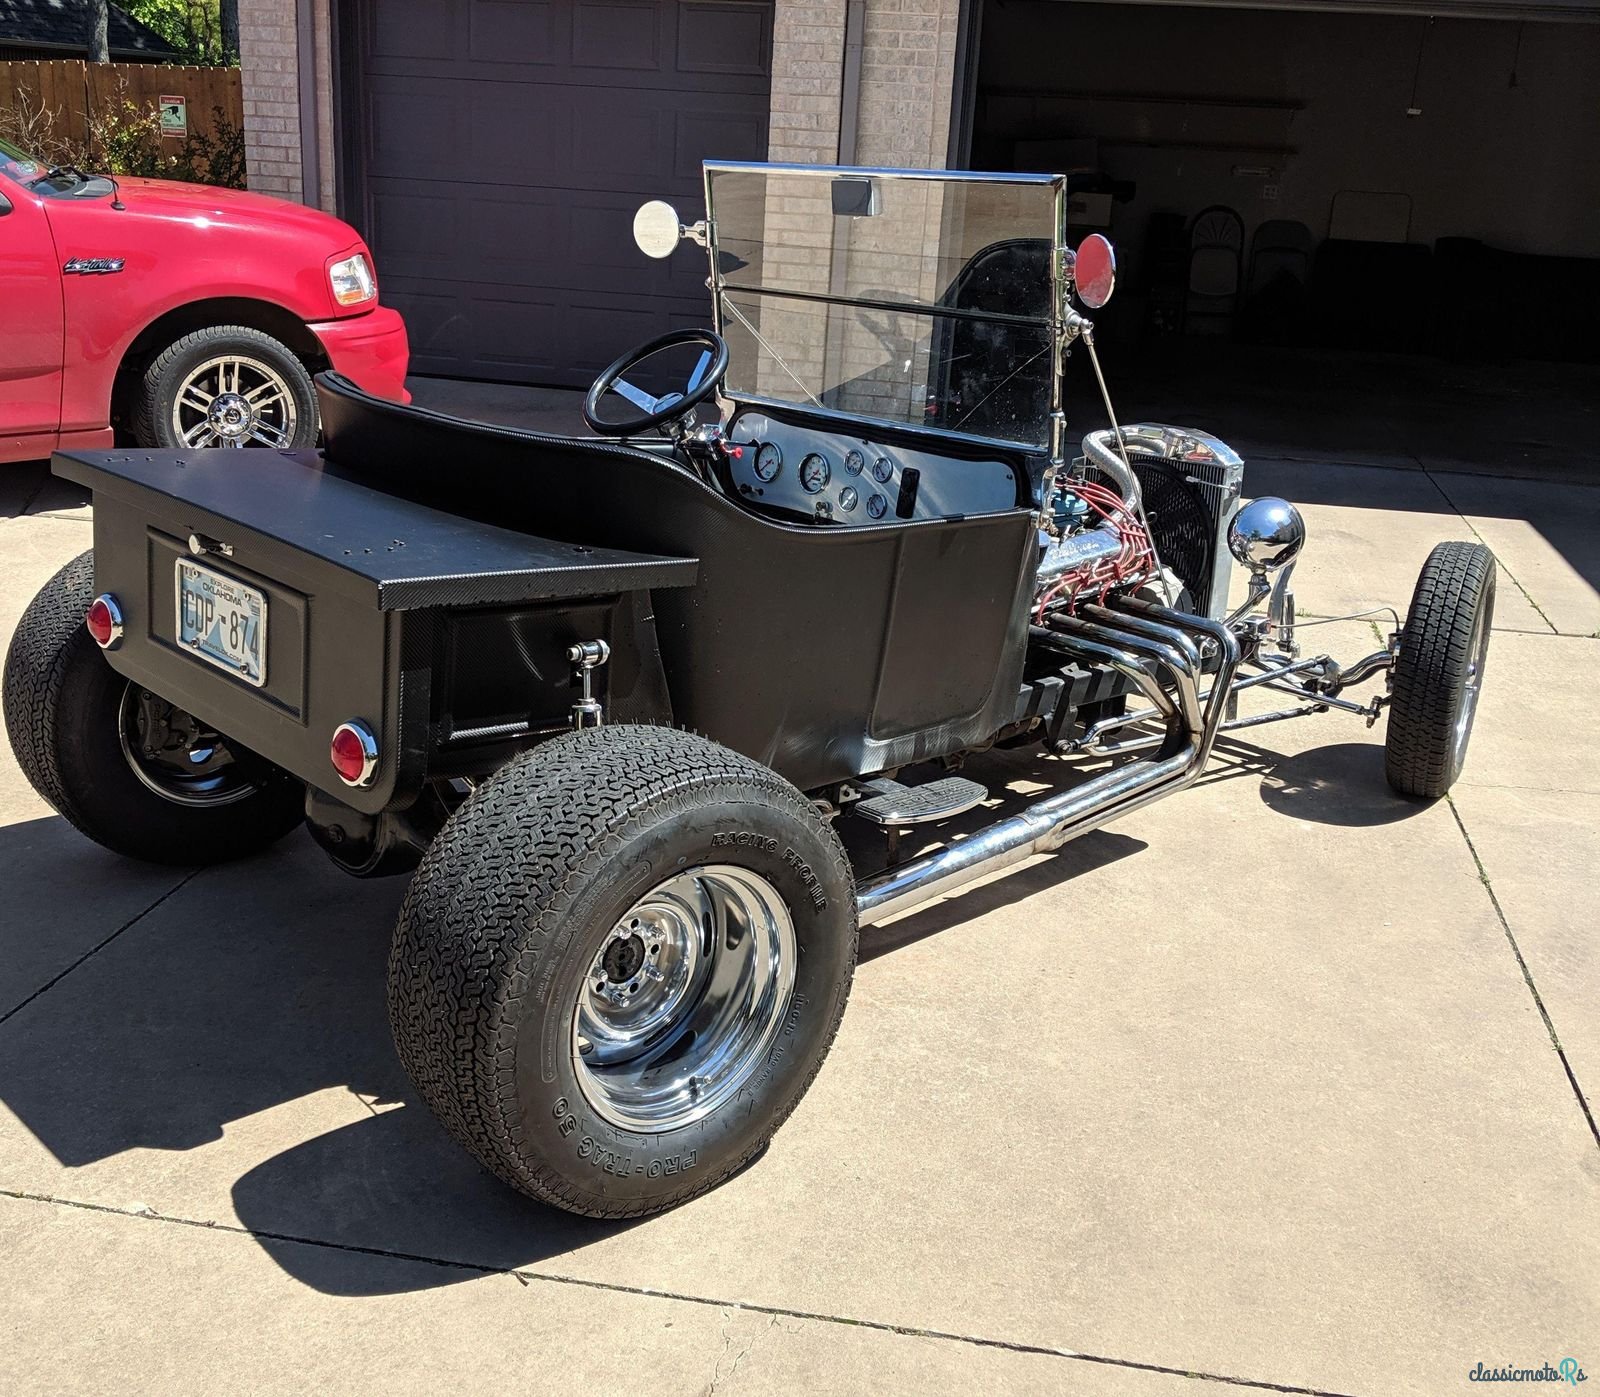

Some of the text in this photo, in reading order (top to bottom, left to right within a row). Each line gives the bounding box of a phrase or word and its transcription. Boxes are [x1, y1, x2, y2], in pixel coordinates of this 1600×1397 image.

[202, 582, 243, 607] OKLAHOMA
[210, 577, 235, 595] EXPLORE
[185, 589, 259, 661] CDP 874
[711, 831, 829, 913] RACING PROFILE
[552, 1096, 698, 1178] PRO-TRAC 50
